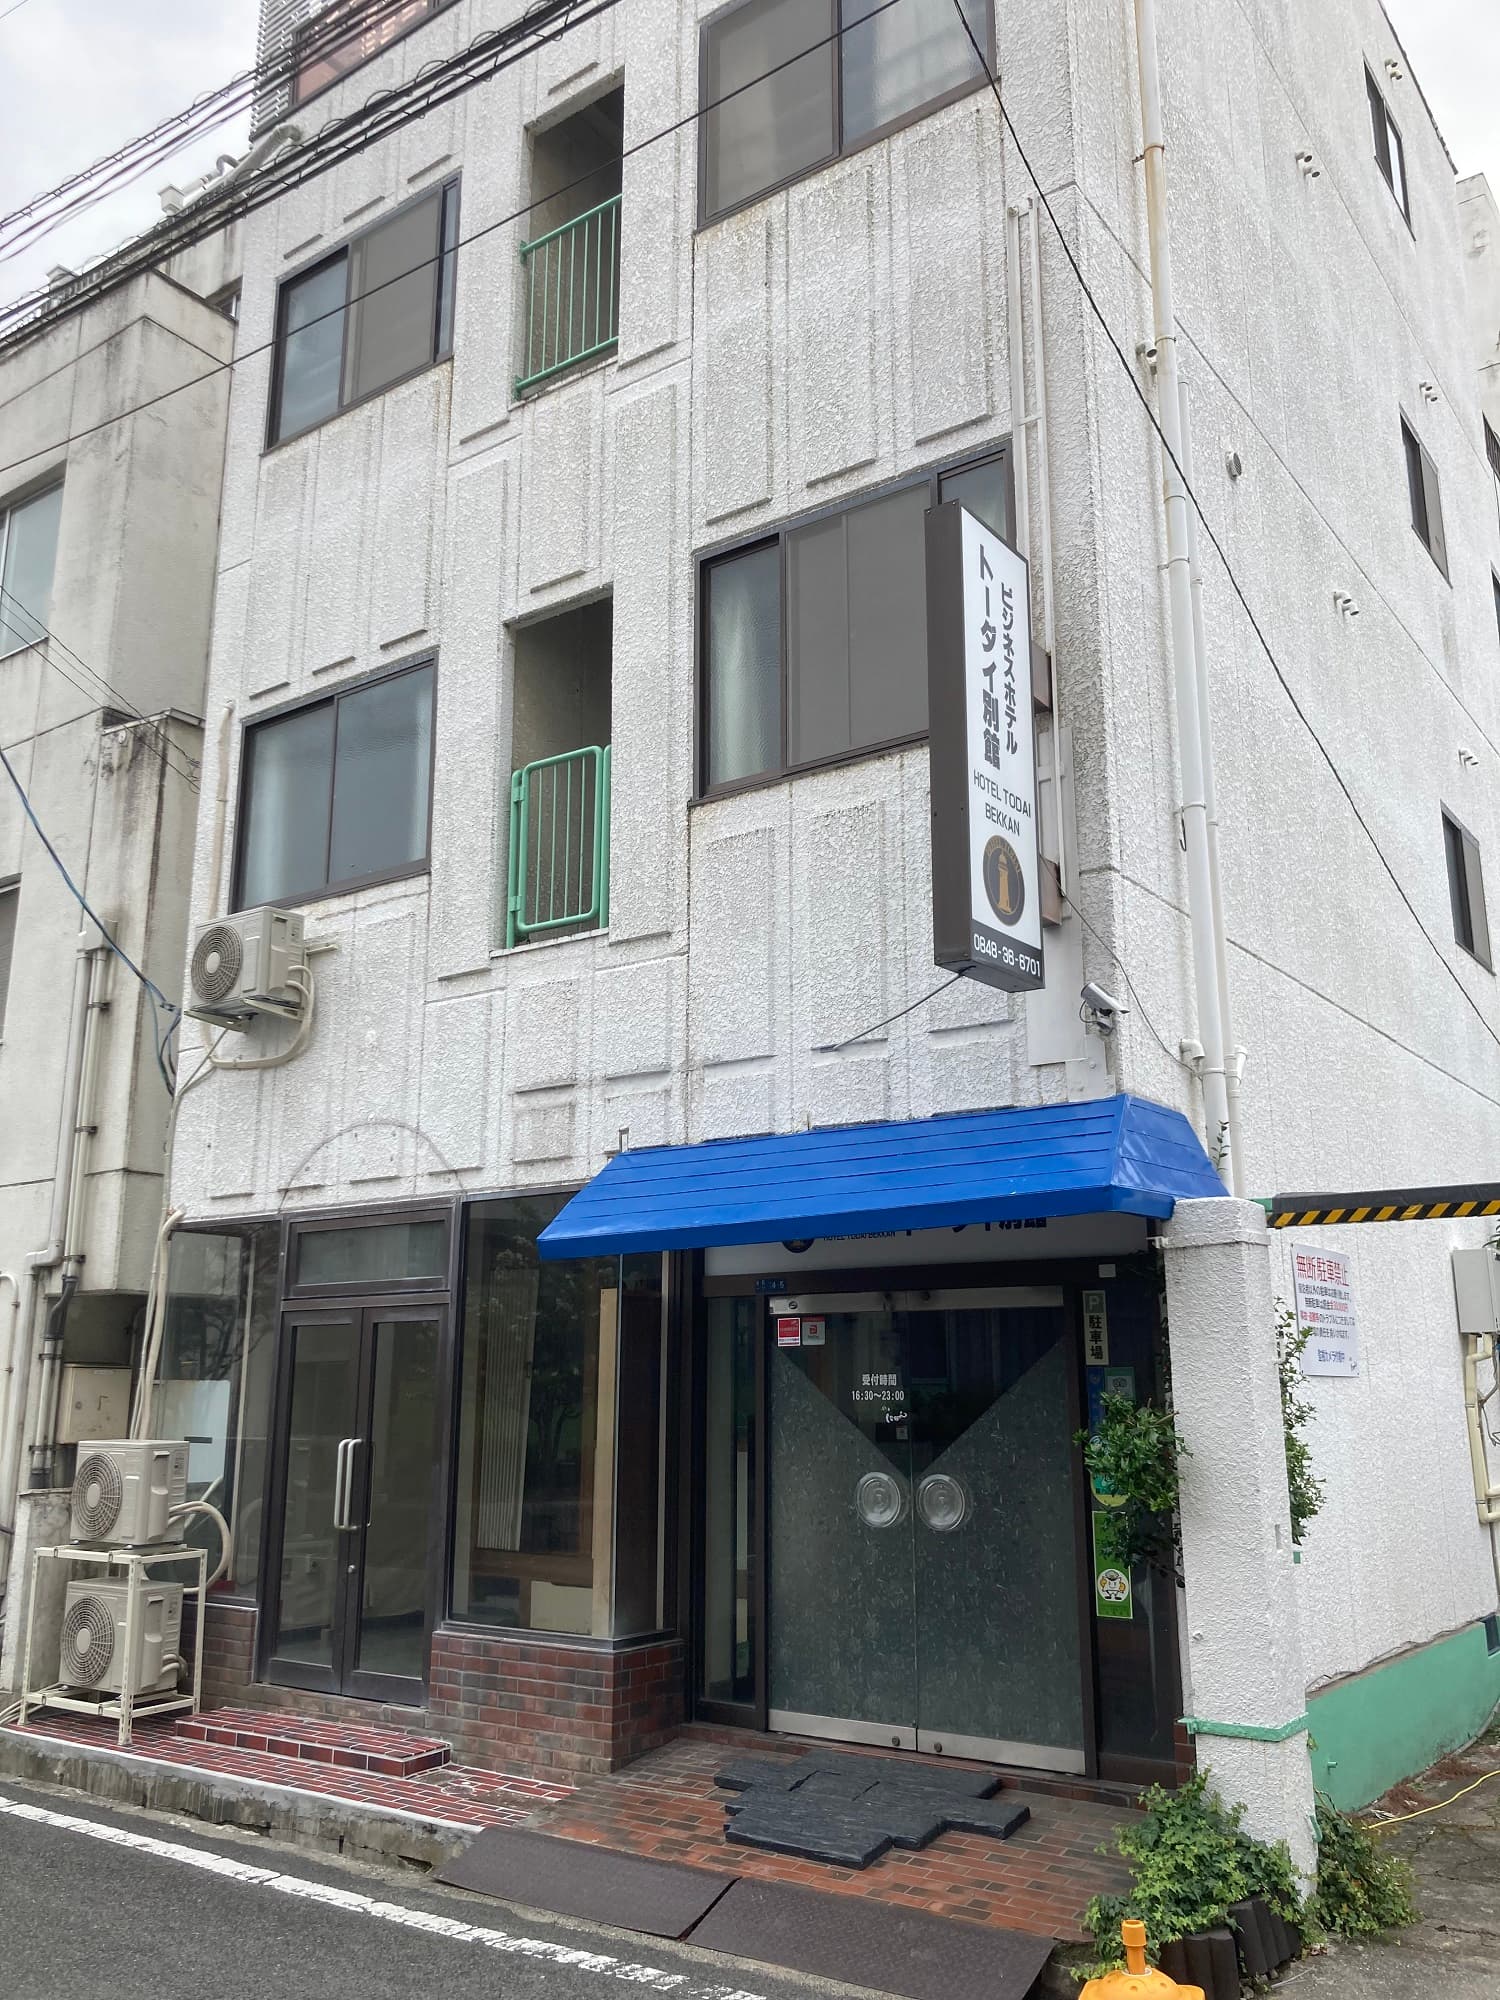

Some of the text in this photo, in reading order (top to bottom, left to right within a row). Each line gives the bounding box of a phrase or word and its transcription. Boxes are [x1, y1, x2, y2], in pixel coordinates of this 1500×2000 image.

[1000, 582, 1018, 755] ビジネスホテル
[973, 770, 1032, 818] HOTEL TODAI
[984, 802, 1021, 837] BEKKAN
[1296, 1253, 1350, 1287] 無断駐車禁止
[1088, 1295, 1099, 1311] P
[1088, 1314, 1104, 1360] 駐車場
[862, 1373, 897, 1386] 受付時間
